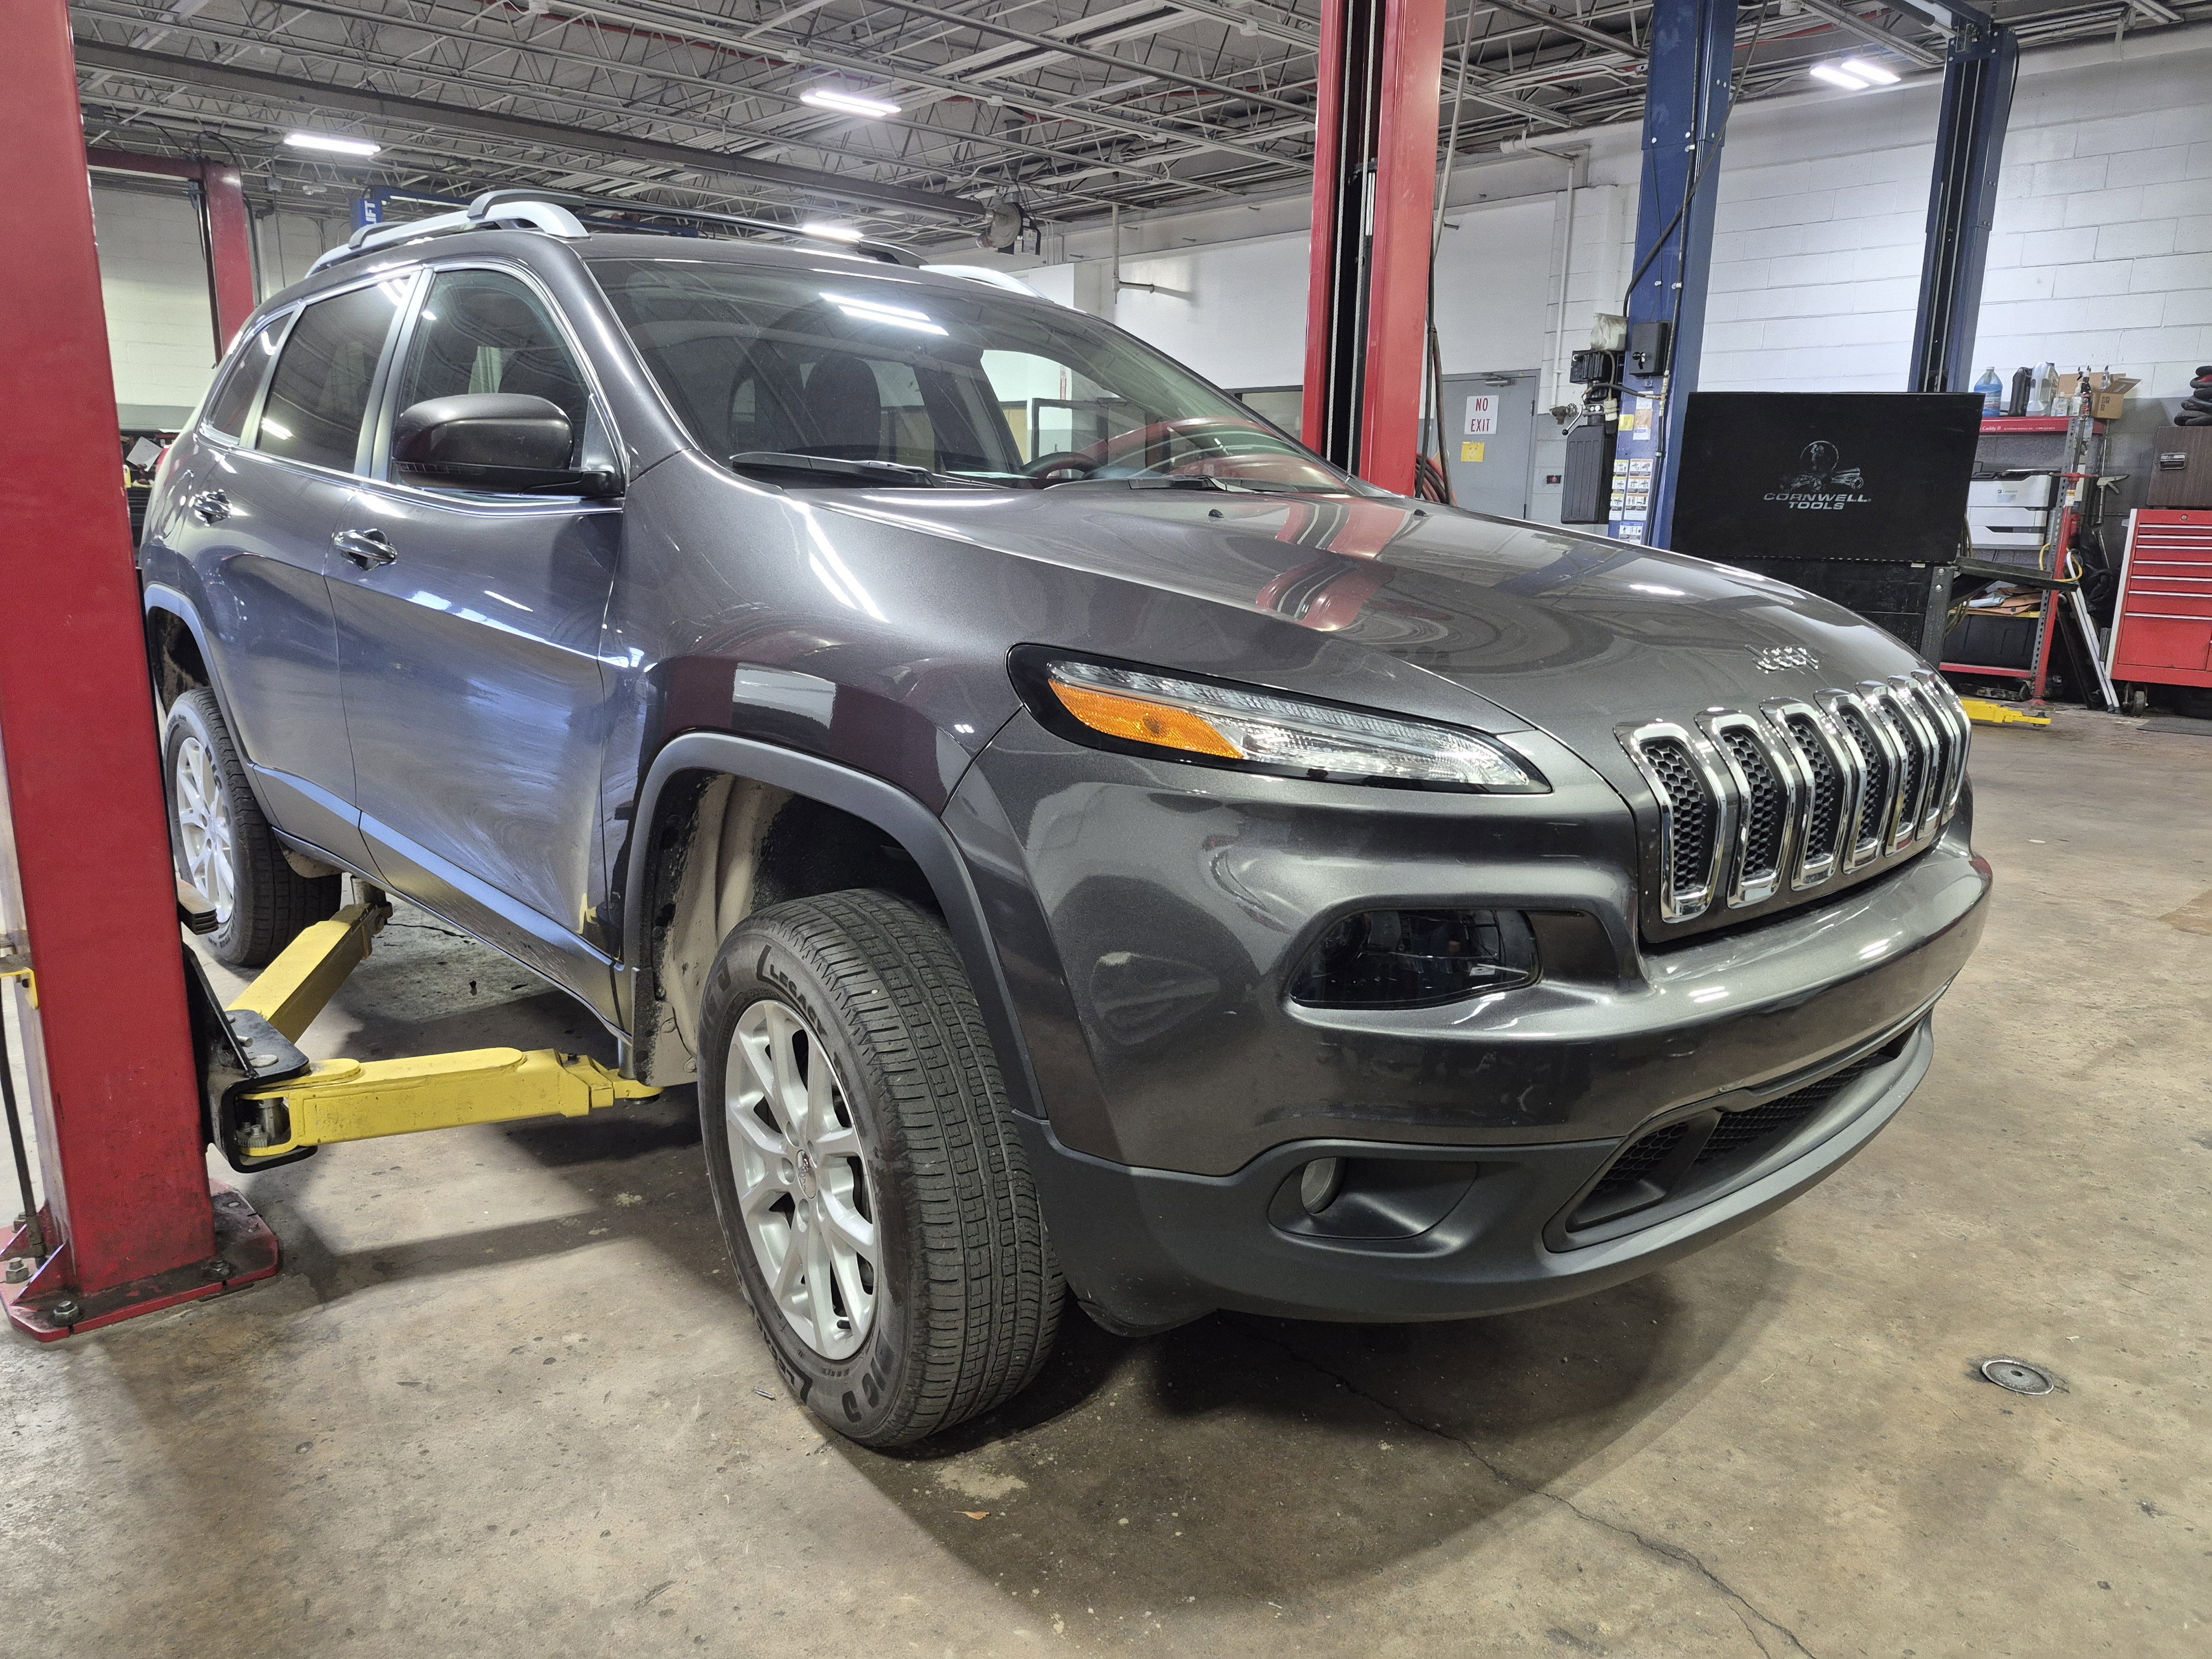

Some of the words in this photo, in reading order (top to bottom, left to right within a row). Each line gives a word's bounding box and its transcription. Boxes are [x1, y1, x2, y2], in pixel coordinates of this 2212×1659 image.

[364, 200, 377, 223] IFT
[1475, 398, 1488, 411] NO
[1470, 419, 1490, 432] EXIT
[1763, 492, 1868, 503] CORNWELL
[1788, 501, 1845, 510] TOOLS
[769, 964, 828, 1037] LEGACY
